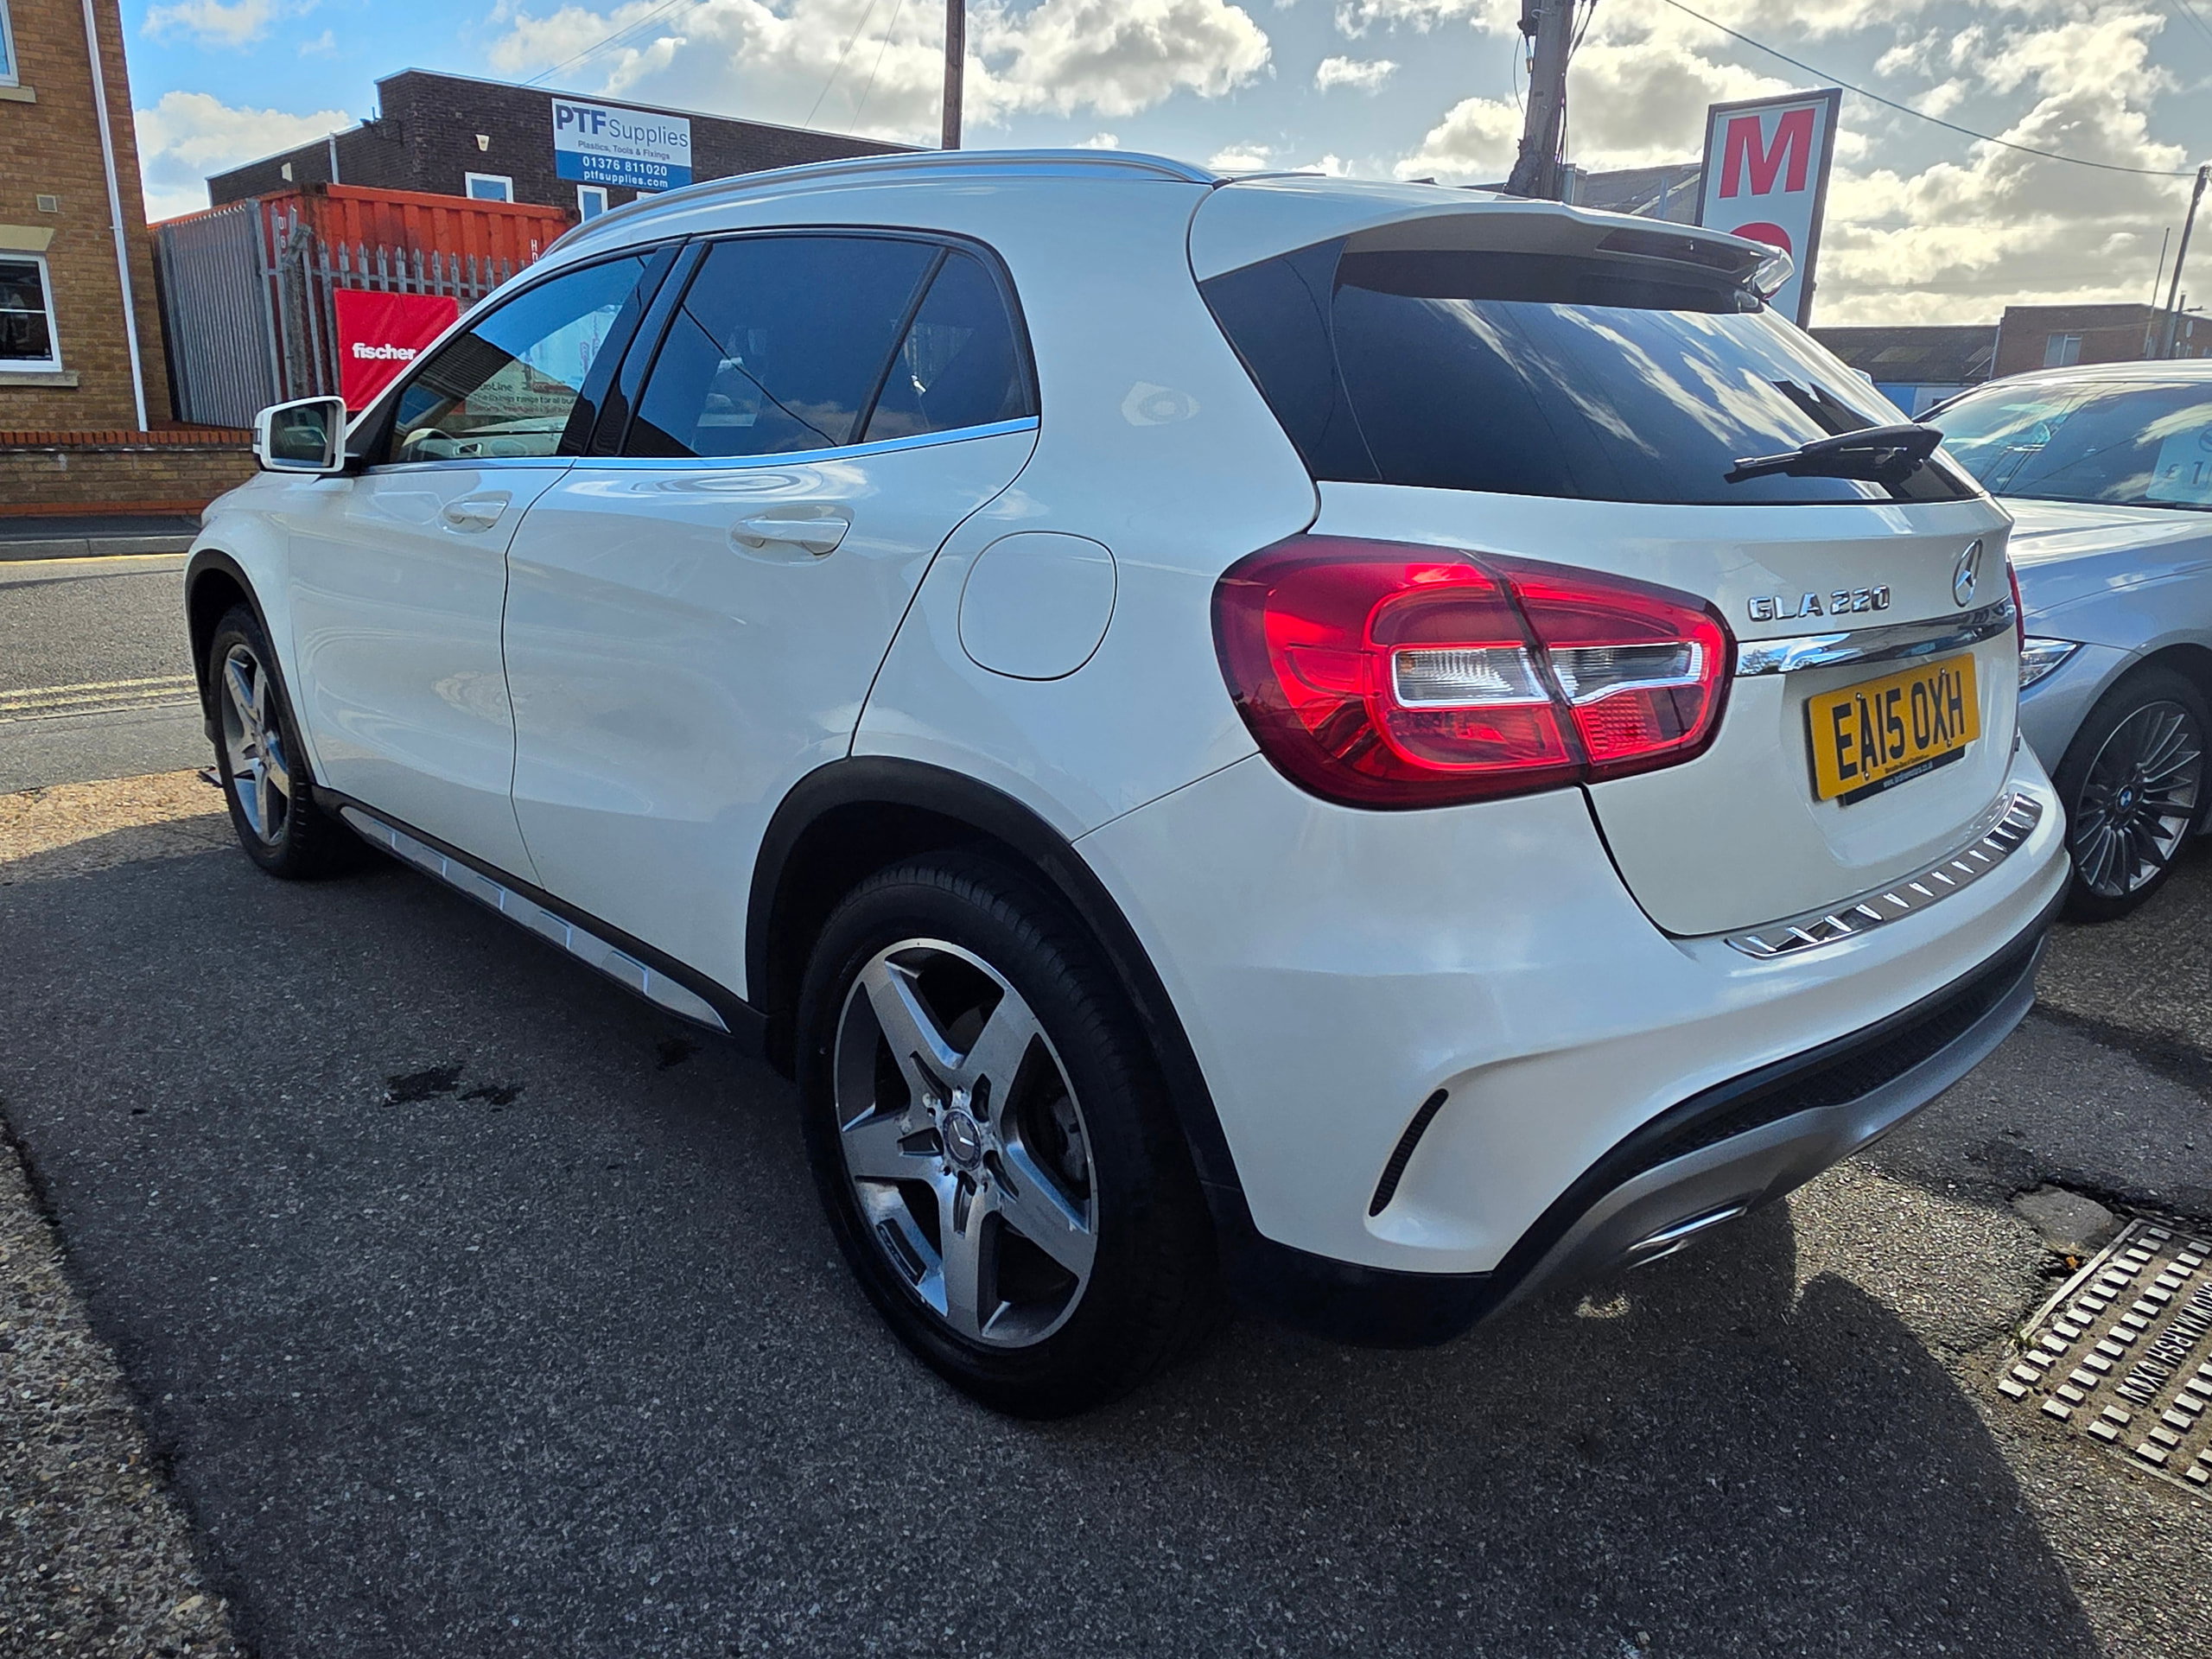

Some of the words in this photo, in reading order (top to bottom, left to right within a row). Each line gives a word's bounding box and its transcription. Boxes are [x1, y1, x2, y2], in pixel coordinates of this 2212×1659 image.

[555, 104, 607, 135] PTF
[609, 119, 689, 148] Supplies
[578, 140, 611, 152] Plastics,
[613, 145, 633, 155] Tools
[643, 149, 671, 161] Fixings
[582, 156, 620, 170] 01376
[625, 161, 667, 176] 811020
[583, 170, 668, 188] ptfsupplies.com
[352, 342, 416, 360] fischer
[1748, 593, 1824, 622] GLA
[1830, 585, 1891, 615] 220
[1832, 689, 1905, 780] EA15
[1910, 671, 1965, 750] OXH
[2114, 1360, 2170, 1405] OXON
